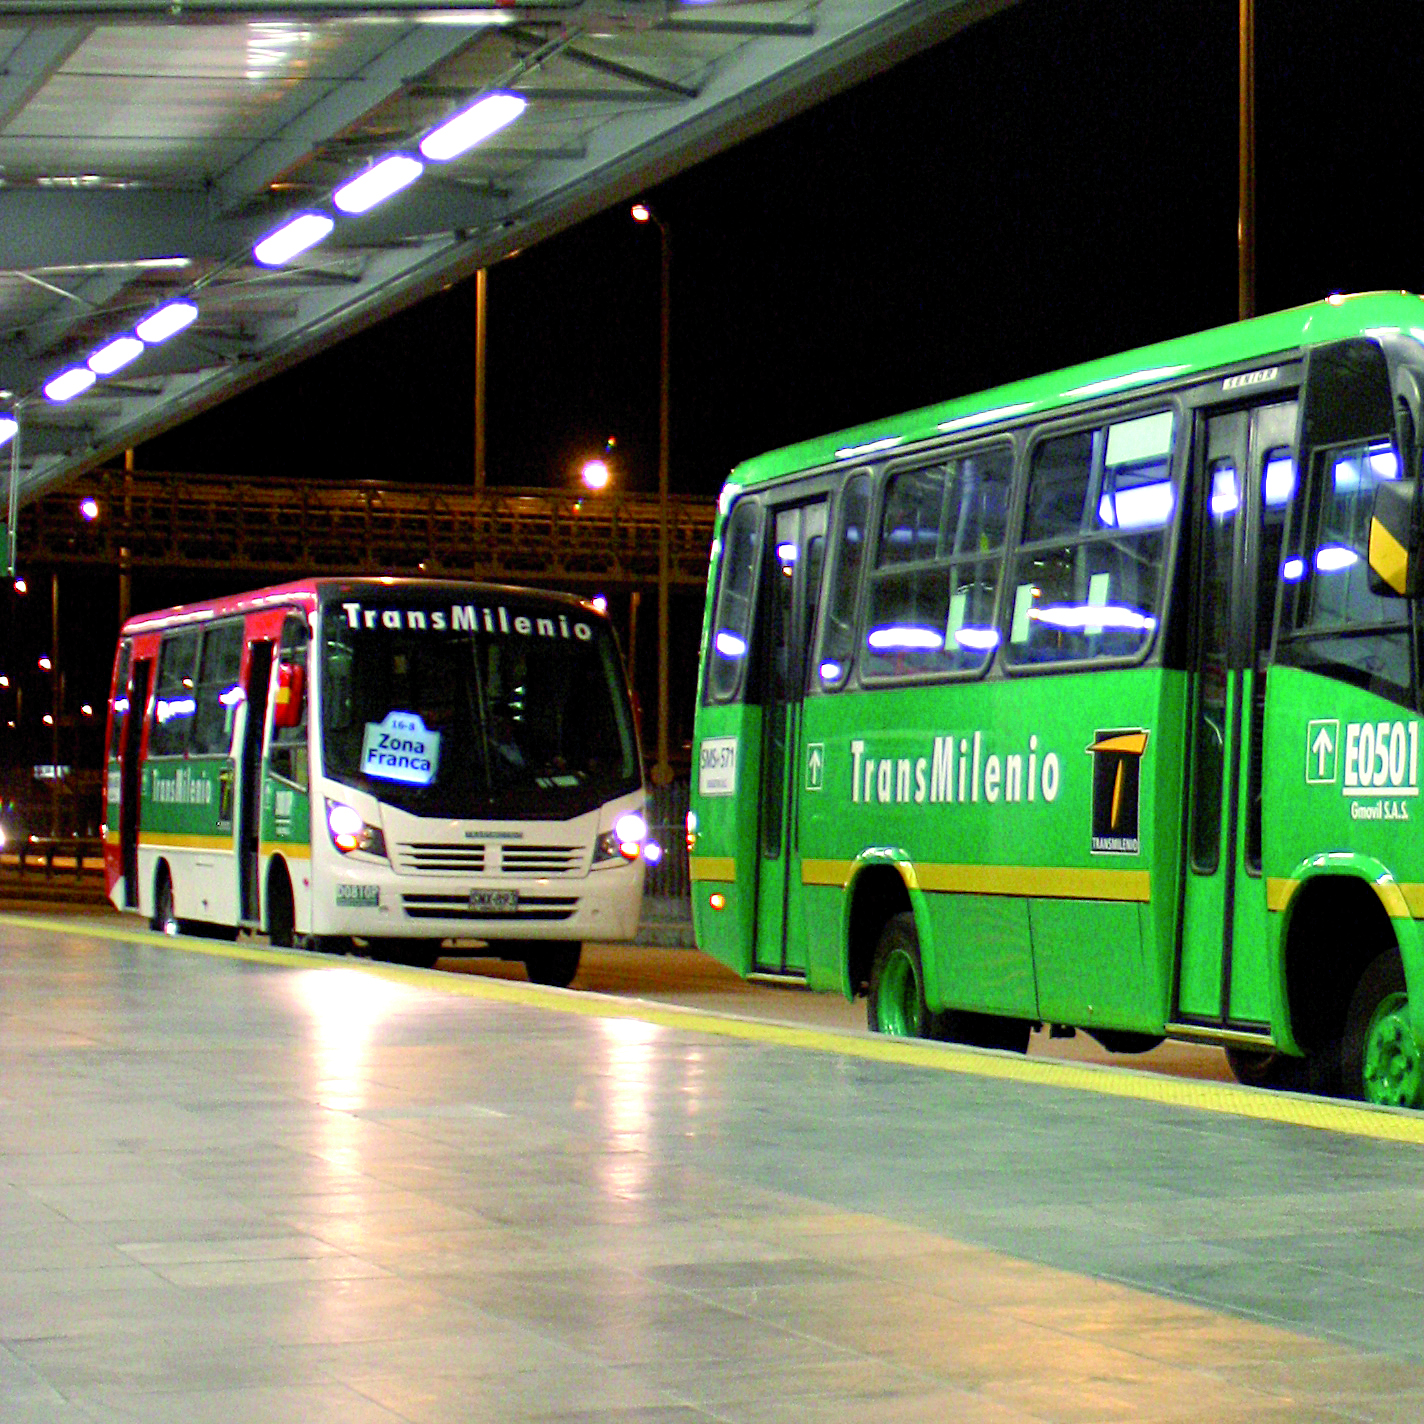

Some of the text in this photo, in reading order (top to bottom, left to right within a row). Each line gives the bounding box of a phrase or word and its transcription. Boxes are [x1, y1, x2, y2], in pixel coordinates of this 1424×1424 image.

[342, 602, 592, 641] TransMilenio
[367, 749, 431, 772] Franca
[378, 733, 425, 755] Zona
[1344, 720, 1419, 787] E0501
[851, 730, 1060, 803] TransMilenio
[152, 767, 212, 804] TransMilenio
[1350, 799, 1383, 820] Gmovil
